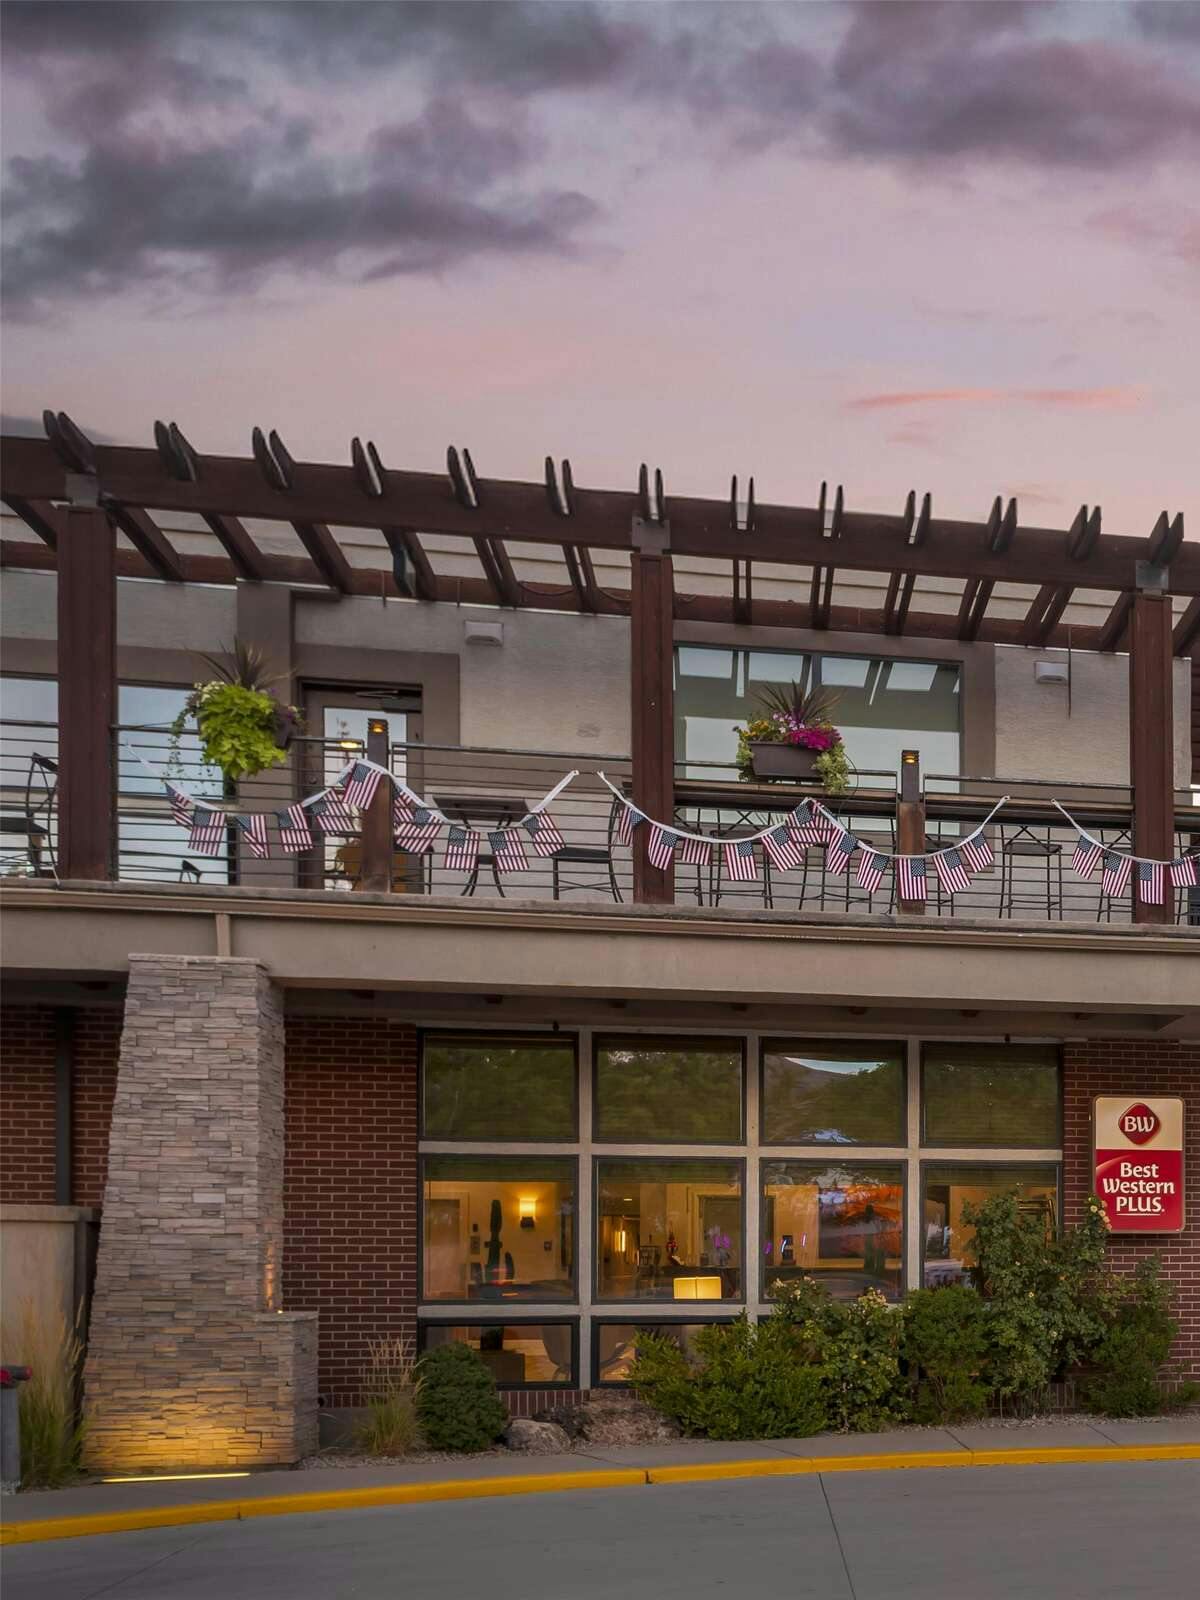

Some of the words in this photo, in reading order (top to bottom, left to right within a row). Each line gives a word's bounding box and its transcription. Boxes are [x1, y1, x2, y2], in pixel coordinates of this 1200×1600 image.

[1124, 1116, 1155, 1132] BW
[1120, 1162, 1159, 1178] Best
[1102, 1178, 1174, 1194] Western
